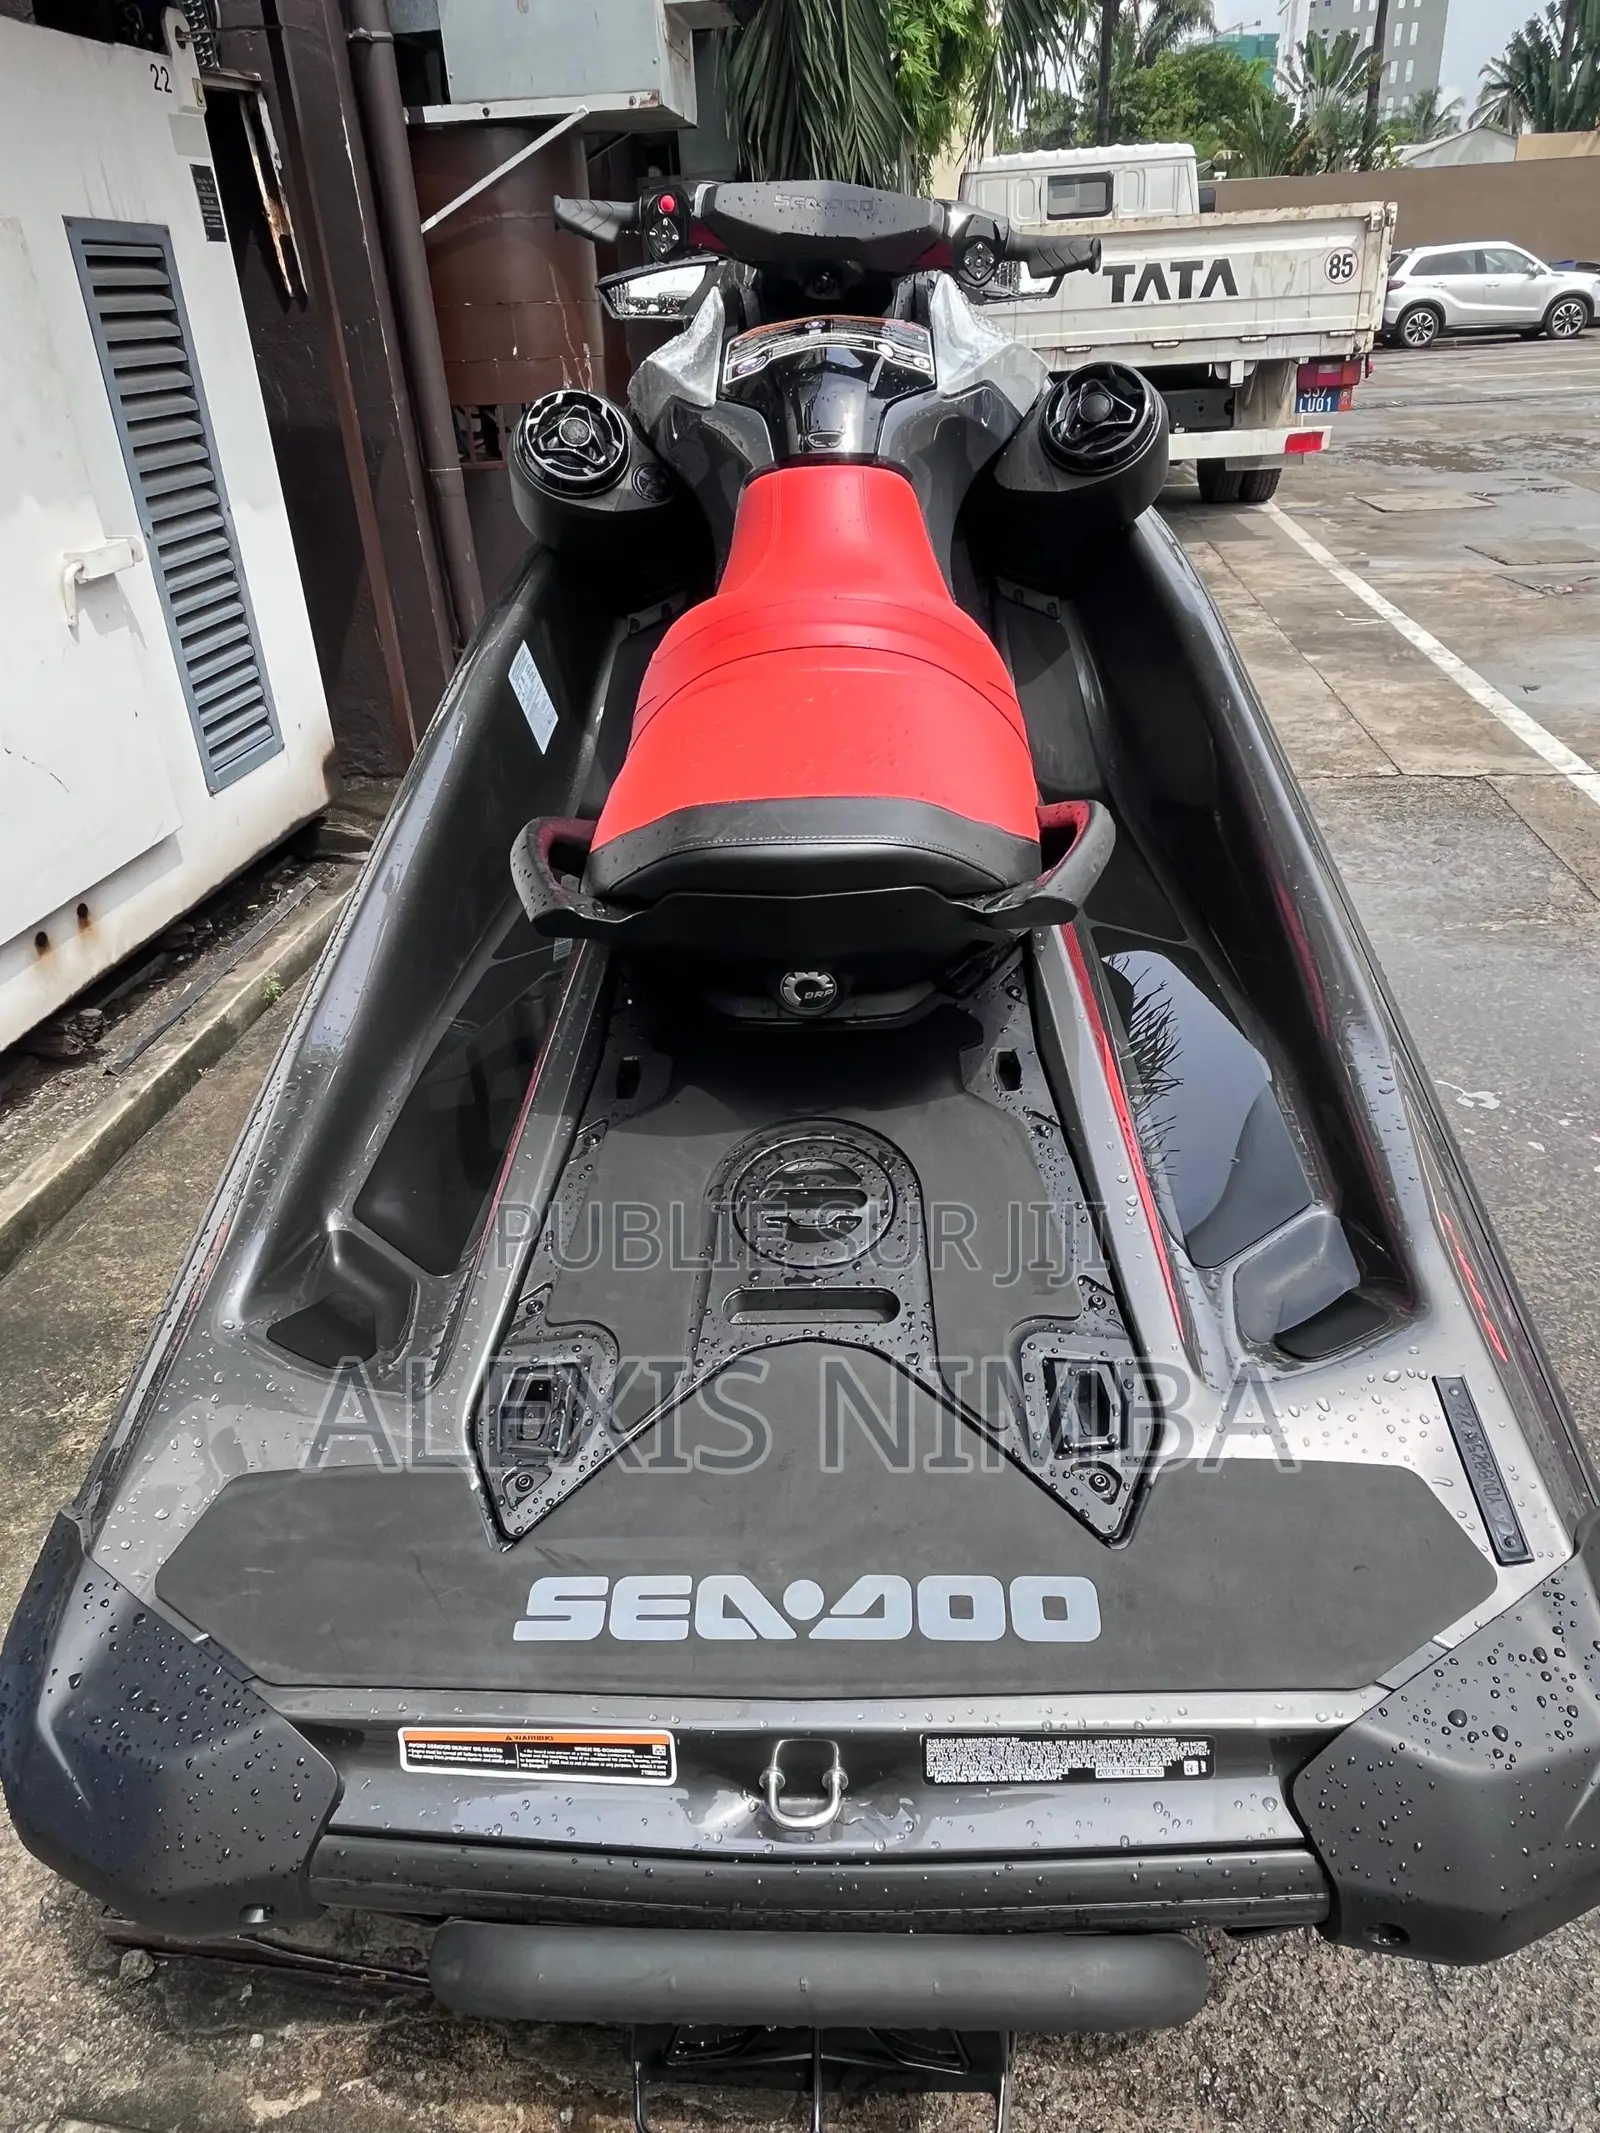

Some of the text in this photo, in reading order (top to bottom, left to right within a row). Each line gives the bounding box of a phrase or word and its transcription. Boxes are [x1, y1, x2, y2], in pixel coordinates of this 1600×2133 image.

[150, 63, 173, 93] 22
[1102, 258, 1239, 304] TATA
[1328, 253, 1354, 280] 85
